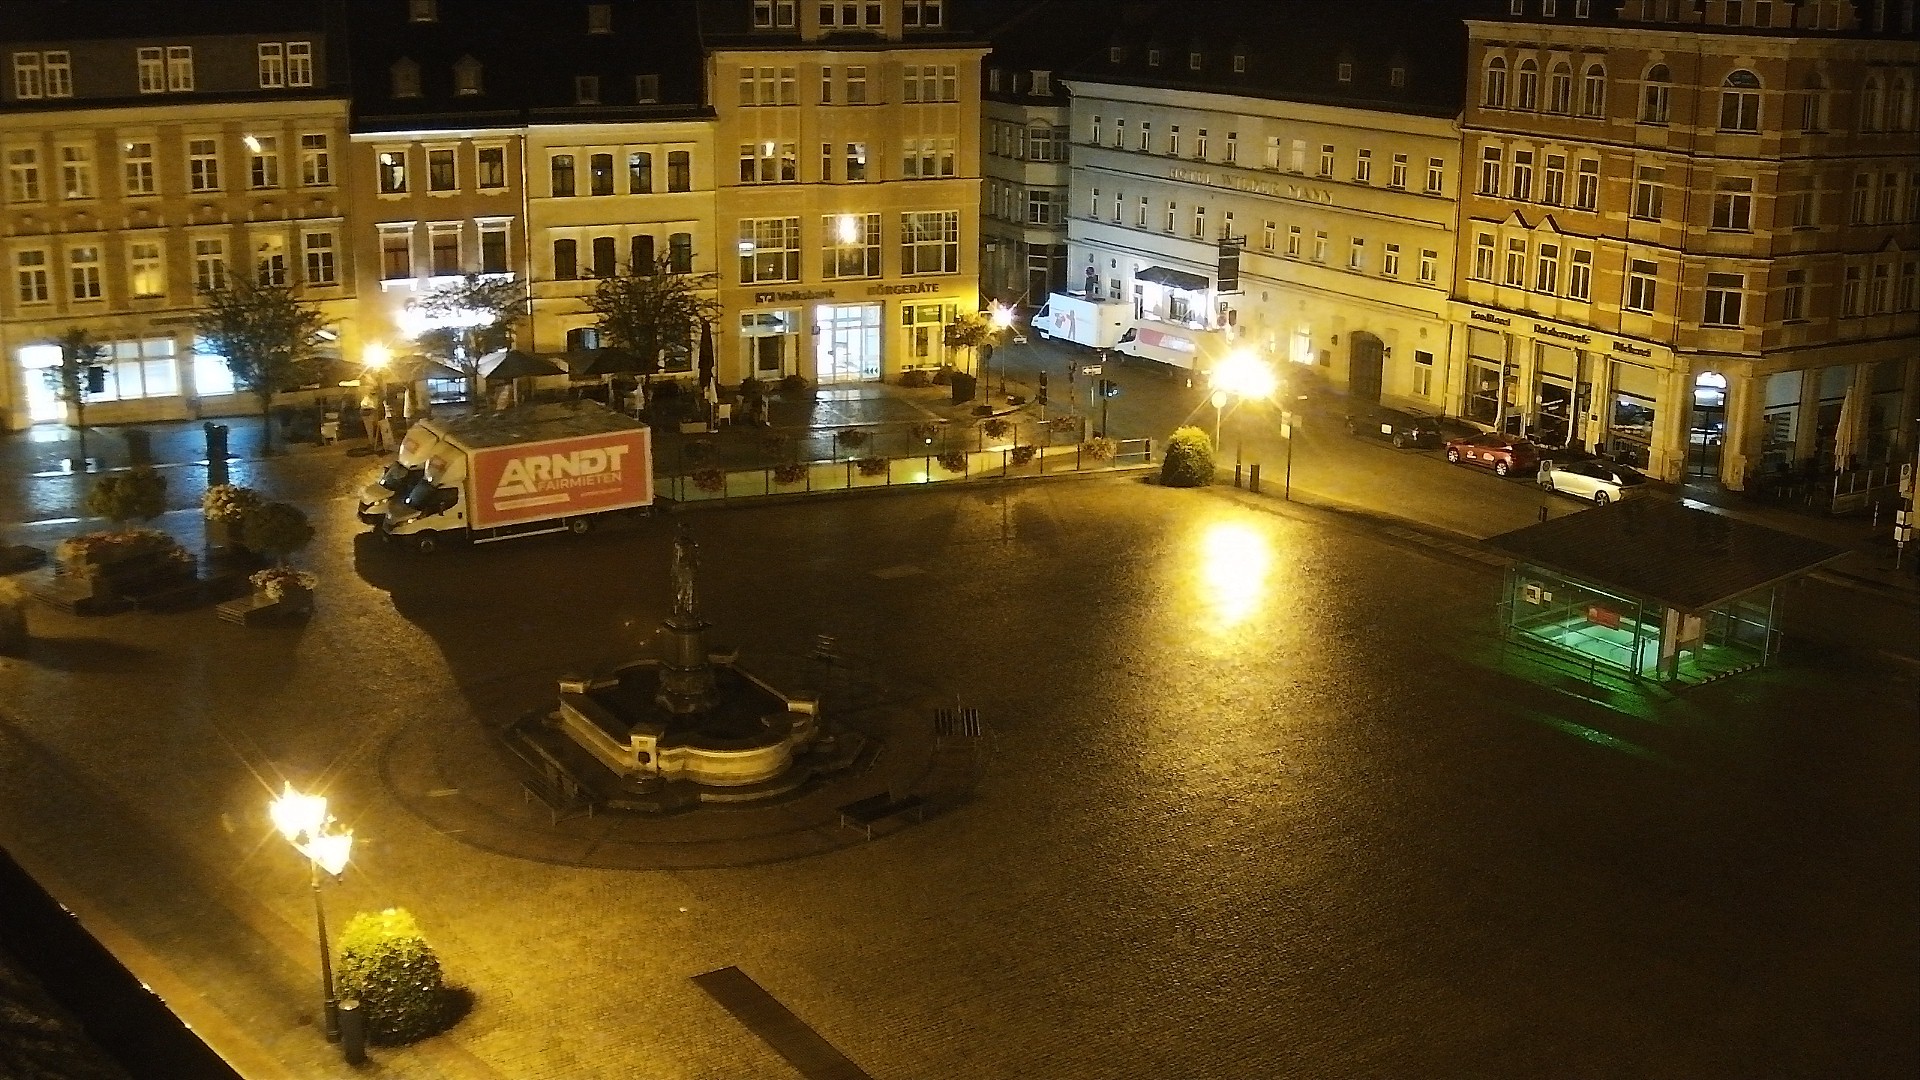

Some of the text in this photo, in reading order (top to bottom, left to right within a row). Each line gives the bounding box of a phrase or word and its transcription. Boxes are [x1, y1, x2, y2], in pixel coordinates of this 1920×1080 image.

[1169, 167, 1212, 185] HOTEL
[1288, 184, 1334, 205] MANN
[777, 288, 835, 301] Volksbank
[866, 282, 940, 297] HÖRGERÄTE
[493, 444, 629, 499] ARNDT
[537, 472, 622, 492] FAIRMIETEN
